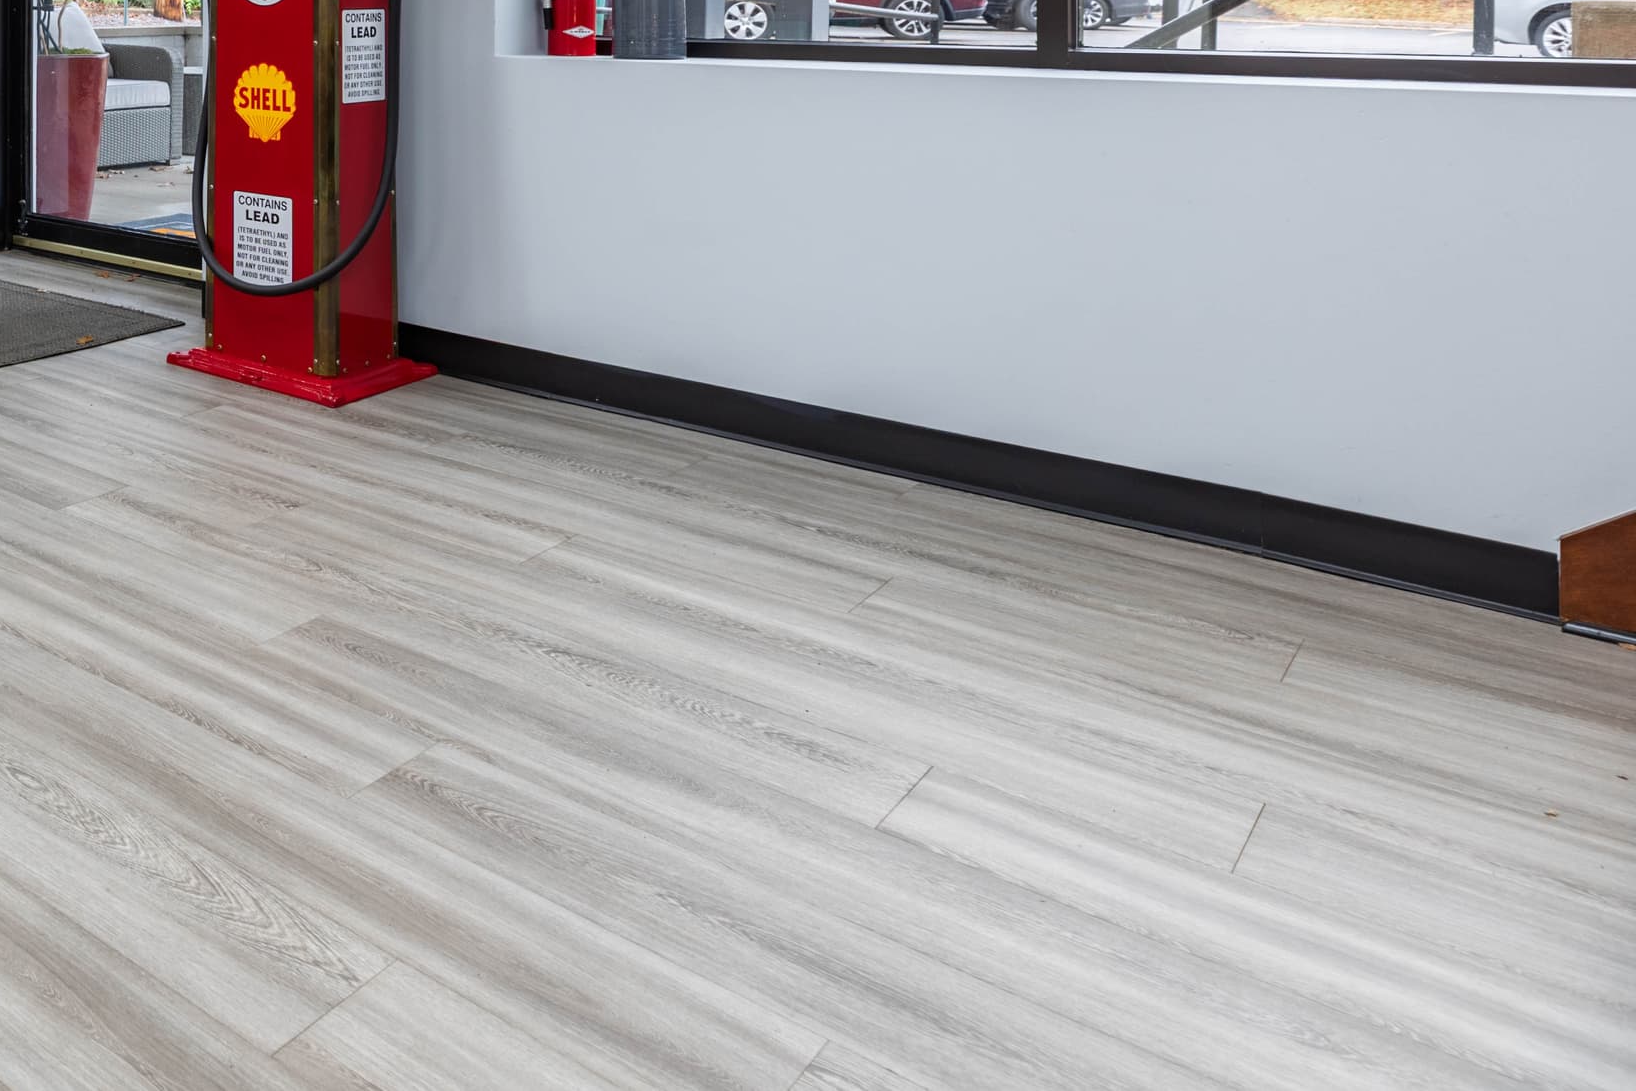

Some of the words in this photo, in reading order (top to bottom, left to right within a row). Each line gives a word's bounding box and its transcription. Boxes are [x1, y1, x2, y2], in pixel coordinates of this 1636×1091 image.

[345, 13, 381, 23] CONTAINS
[351, 27, 376, 38] LEAD
[239, 87, 291, 113] SHELL
[238, 195, 287, 211] CONTAINS
[246, 209, 279, 224] LEAD
[277, 232, 288, 240] AND
[238, 243, 256, 252] MOTOR
[258, 246, 271, 254] FUEL
[245, 262, 256, 270] ANY
[258, 264, 275, 272] OTHER
[262, 256, 288, 267] CLEANING
[242, 270, 258, 278] AVOID
[260, 272, 284, 283] SPILLING
